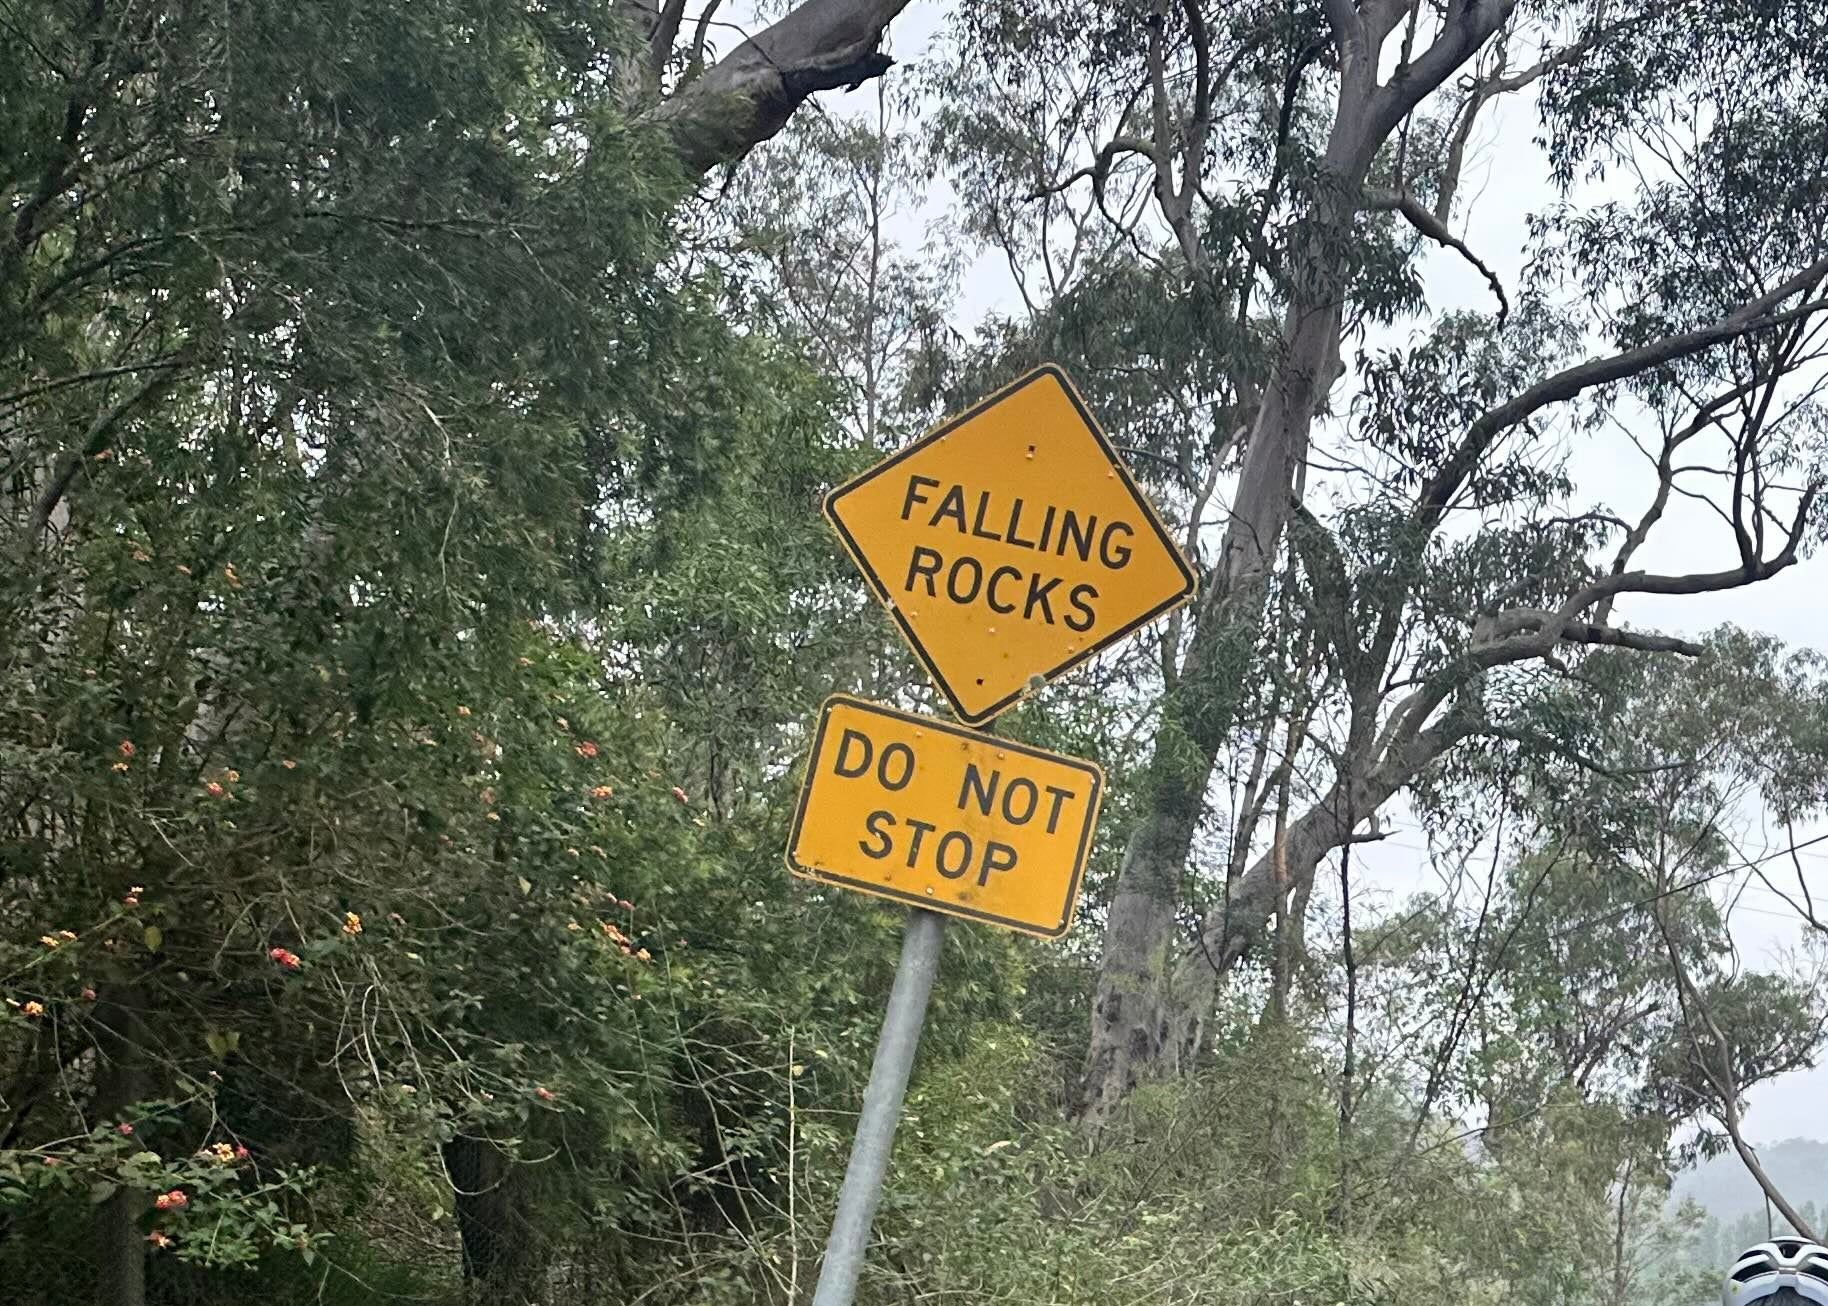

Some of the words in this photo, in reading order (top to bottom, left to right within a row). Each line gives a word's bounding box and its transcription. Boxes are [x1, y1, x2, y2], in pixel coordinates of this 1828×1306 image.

[901, 475, 1135, 570] FALLING
[905, 546, 1099, 632] ROCKS
[834, 730, 916, 792] DO
[957, 764, 1075, 835] NOT
[858, 809, 1018, 888] STOP
